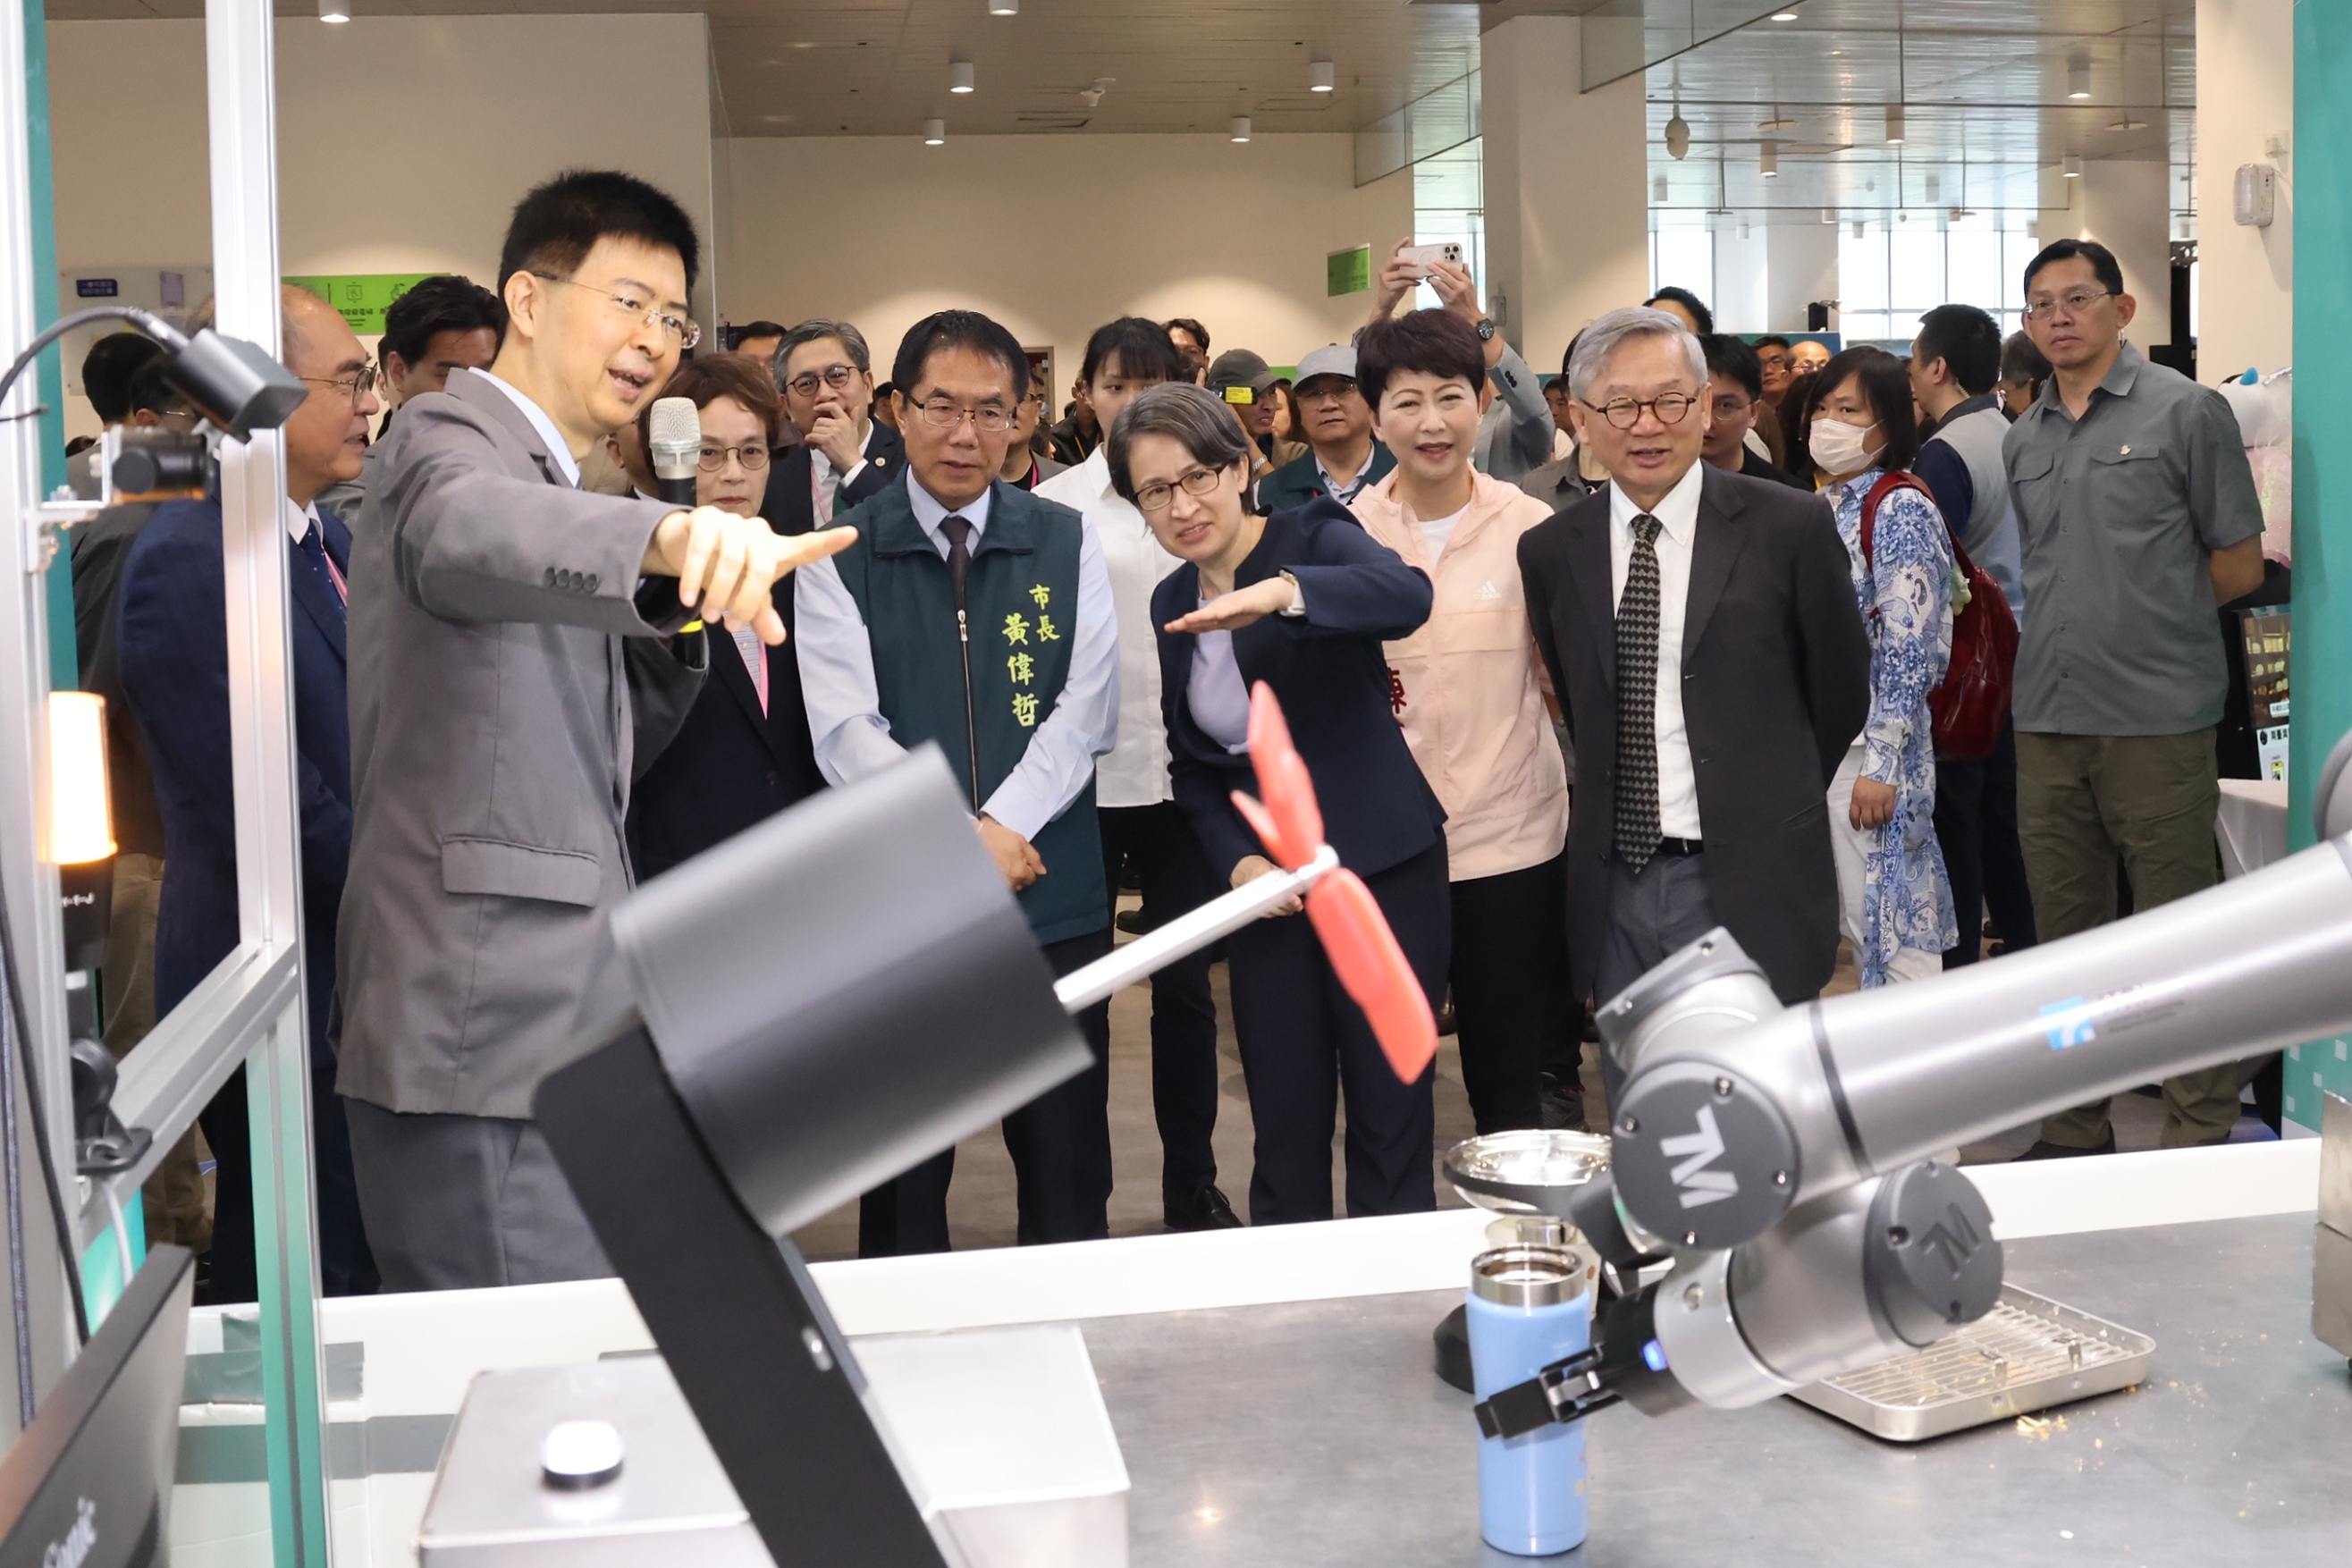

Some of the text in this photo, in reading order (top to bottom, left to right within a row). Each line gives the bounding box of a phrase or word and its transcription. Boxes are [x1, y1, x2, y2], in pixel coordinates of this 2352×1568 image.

[1029, 584, 1060, 643] 市長
[1002, 612, 1040, 727] 黃偉哲
